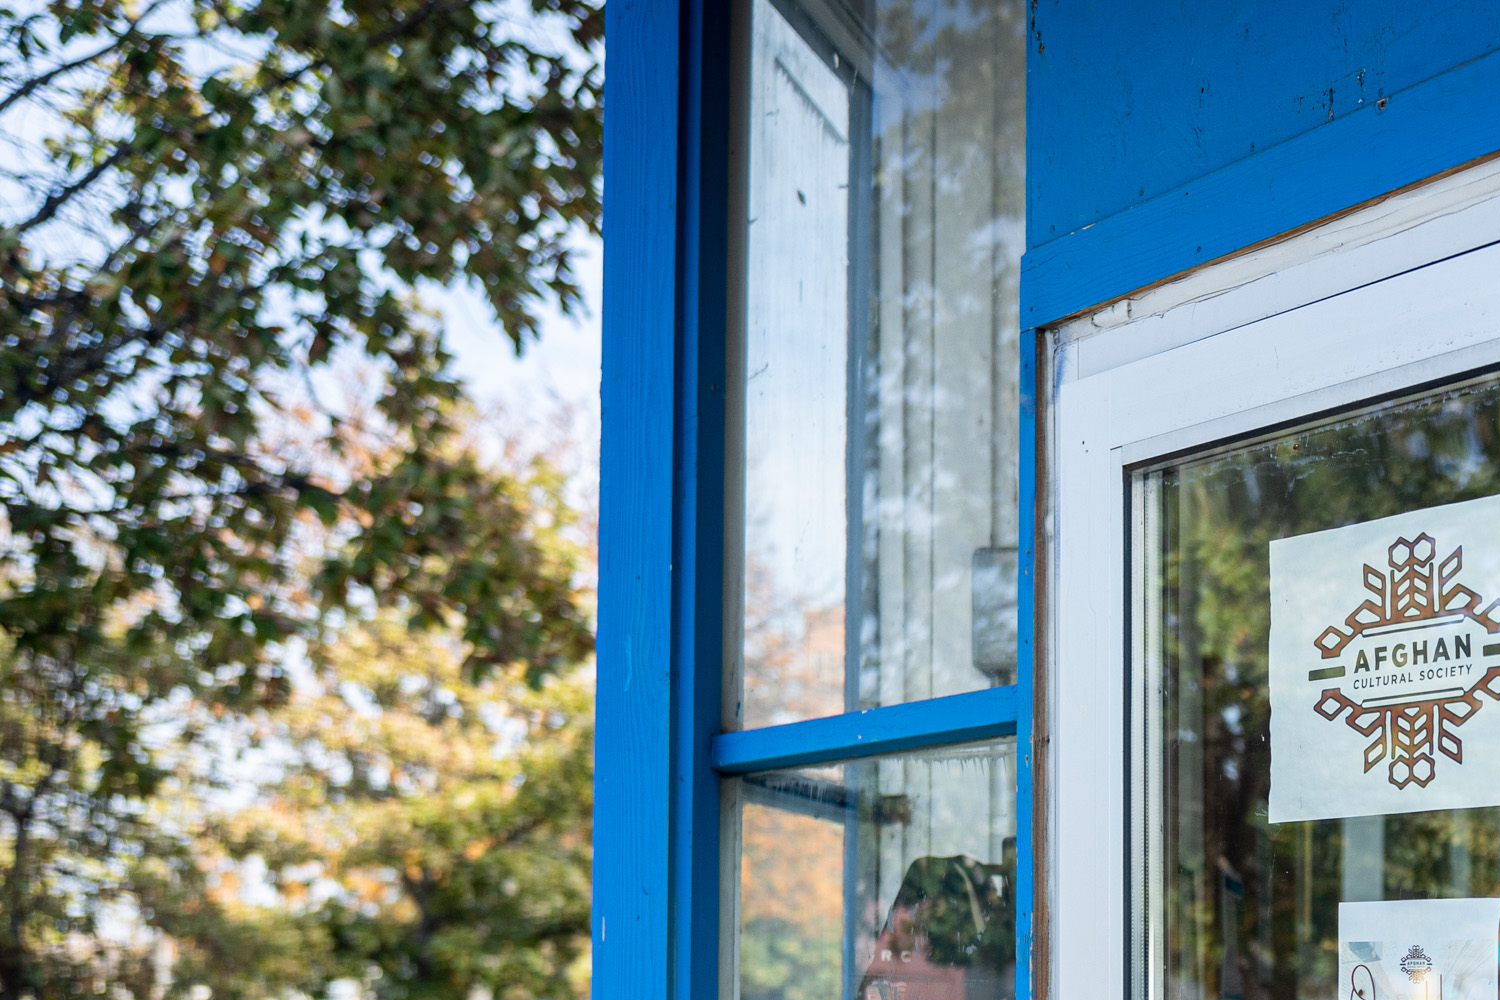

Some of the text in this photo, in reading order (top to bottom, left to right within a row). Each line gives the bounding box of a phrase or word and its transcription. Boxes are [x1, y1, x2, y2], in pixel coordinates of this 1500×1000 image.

[1353, 633, 1472, 674] AFGHAN
[1353, 663, 1473, 690] CULTURAL SOCIETY
